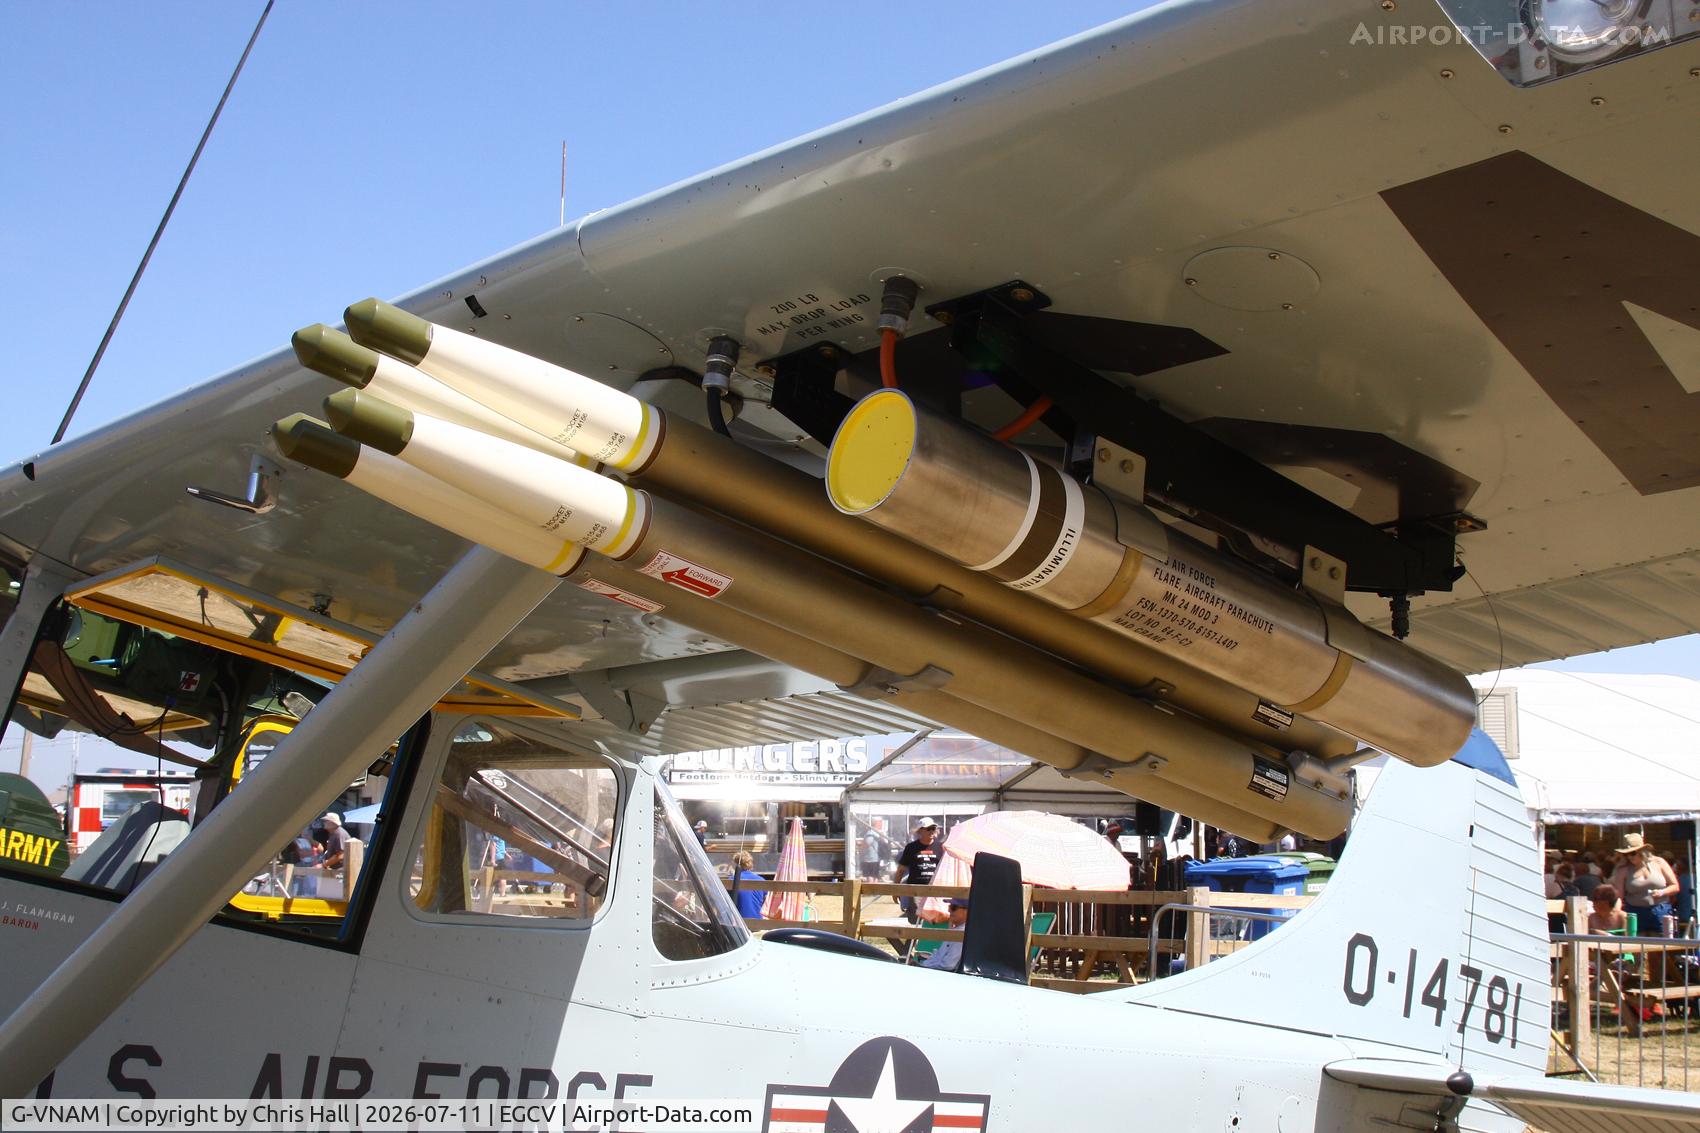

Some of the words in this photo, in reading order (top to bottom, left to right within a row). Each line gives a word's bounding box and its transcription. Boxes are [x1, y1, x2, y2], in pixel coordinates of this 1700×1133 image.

[757, 320, 791, 336] MAX
[790, 308, 827, 325] DROP
[829, 293, 871, 312] LOAD
[770, 301, 797, 314] 200
[797, 293, 820, 305] LB
[796, 325, 828, 339] PER
[826, 313, 865, 329] WING
[688, 568, 723, 587] FORWARD
[1172, 559, 1186, 574] AIR
[1189, 567, 1216, 589] FORCE
[1153, 567, 1182, 591] FLARE,
[1184, 583, 1226, 610] AIRCRAFT
[1227, 602, 1275, 634] PARACHUTE
[1162, 590, 1178, 605] MK
[1178, 598, 1190, 610] 24
[1190, 604, 1211, 621] MOD
[1211, 615, 1219, 625] 3
[1125, 609, 1145, 621] LOT
[1144, 617, 1160, 629] NO
[793, 774, 828, 782] Skinny
[2, 915, 40, 930] BARON
[16, 904, 75, 924] FLANAGAN
[240, 1053, 374, 1133] AIR
[408, 1061, 653, 1133] FORCE
